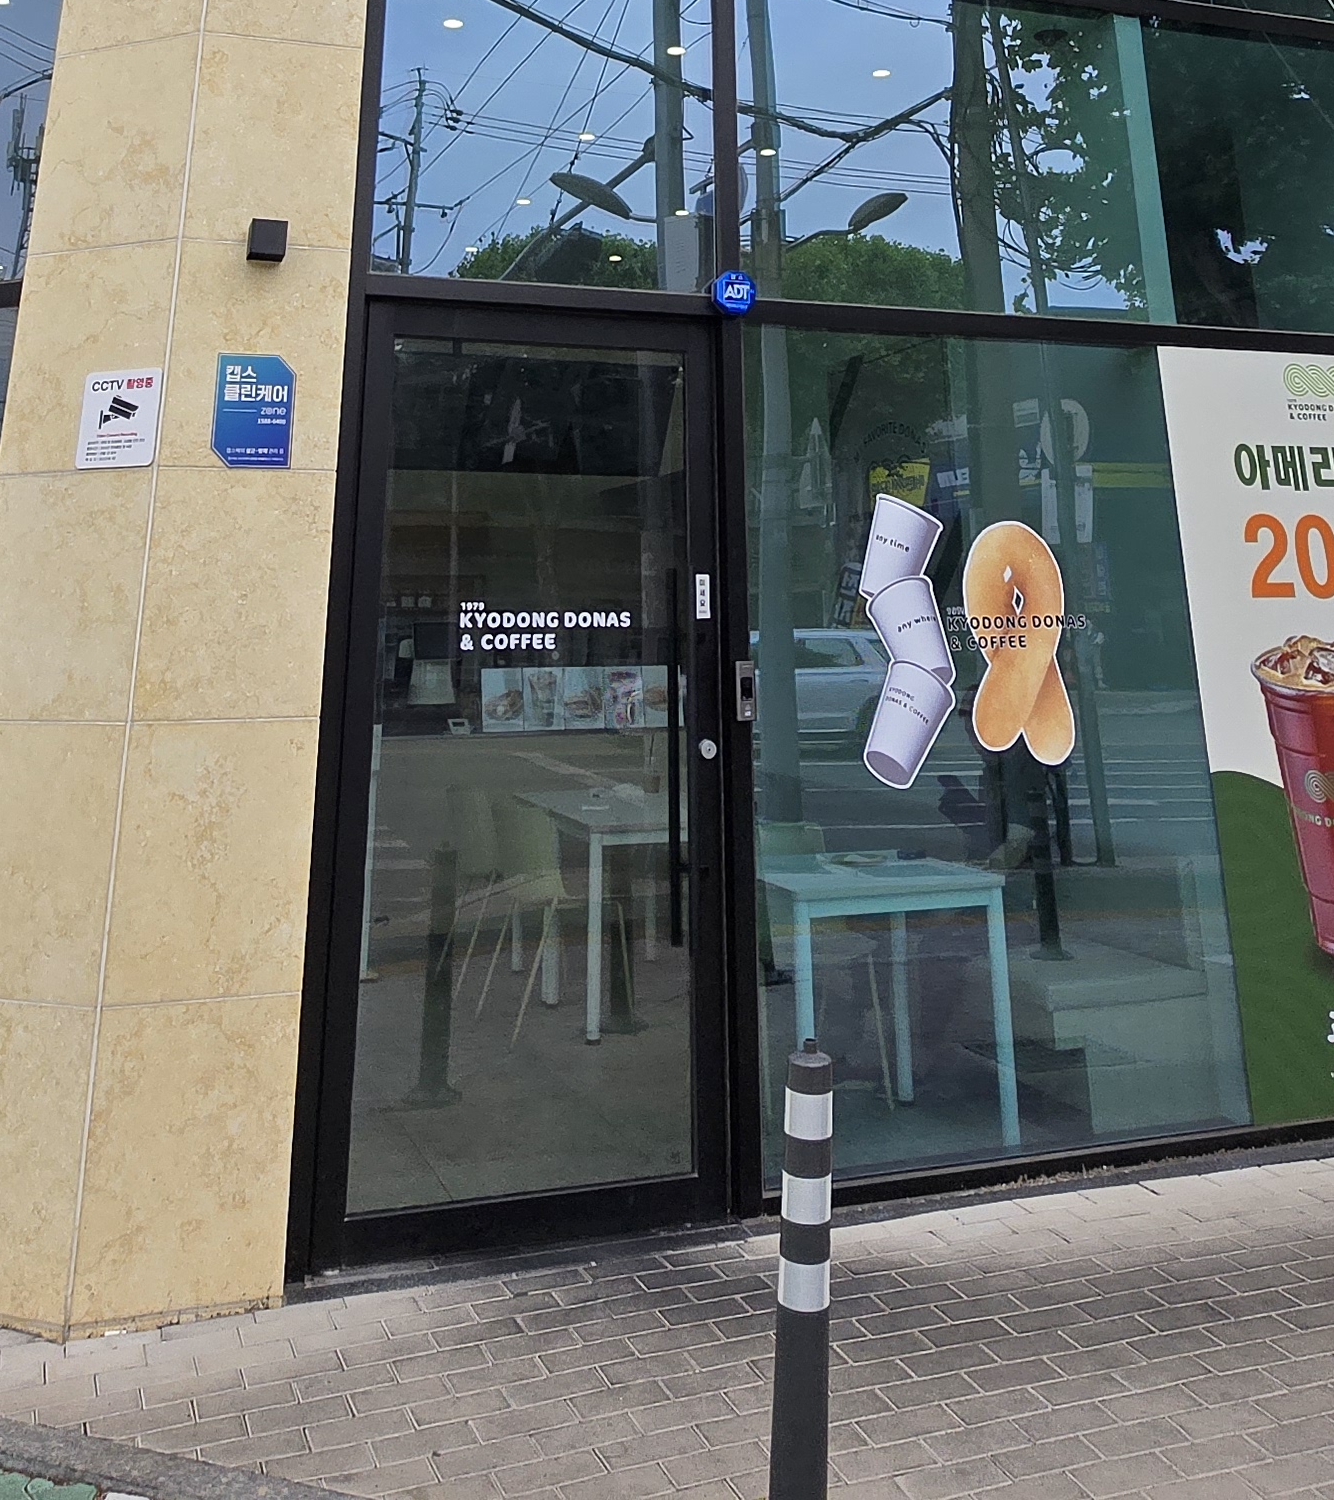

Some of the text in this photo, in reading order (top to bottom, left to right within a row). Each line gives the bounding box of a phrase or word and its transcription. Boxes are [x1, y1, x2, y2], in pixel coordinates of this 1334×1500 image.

[724, 284, 750, 300] ADT
[225, 365, 257, 383] 캡스
[91, 379, 125, 392] CCTV
[223, 384, 289, 403] 클린케어
[1287, 403, 1328, 412] KYODONG
[1289, 412, 1328, 421] & COFFEE
[889, 536, 910, 553] time
[460, 601, 485, 611] 1979
[459, 611, 631, 628] KYODONG DONAS
[947, 614, 1087, 632] KYODONG DONAS
[460, 633, 556, 650] & COFFEE
[950, 634, 1028, 650] & COFFEE
